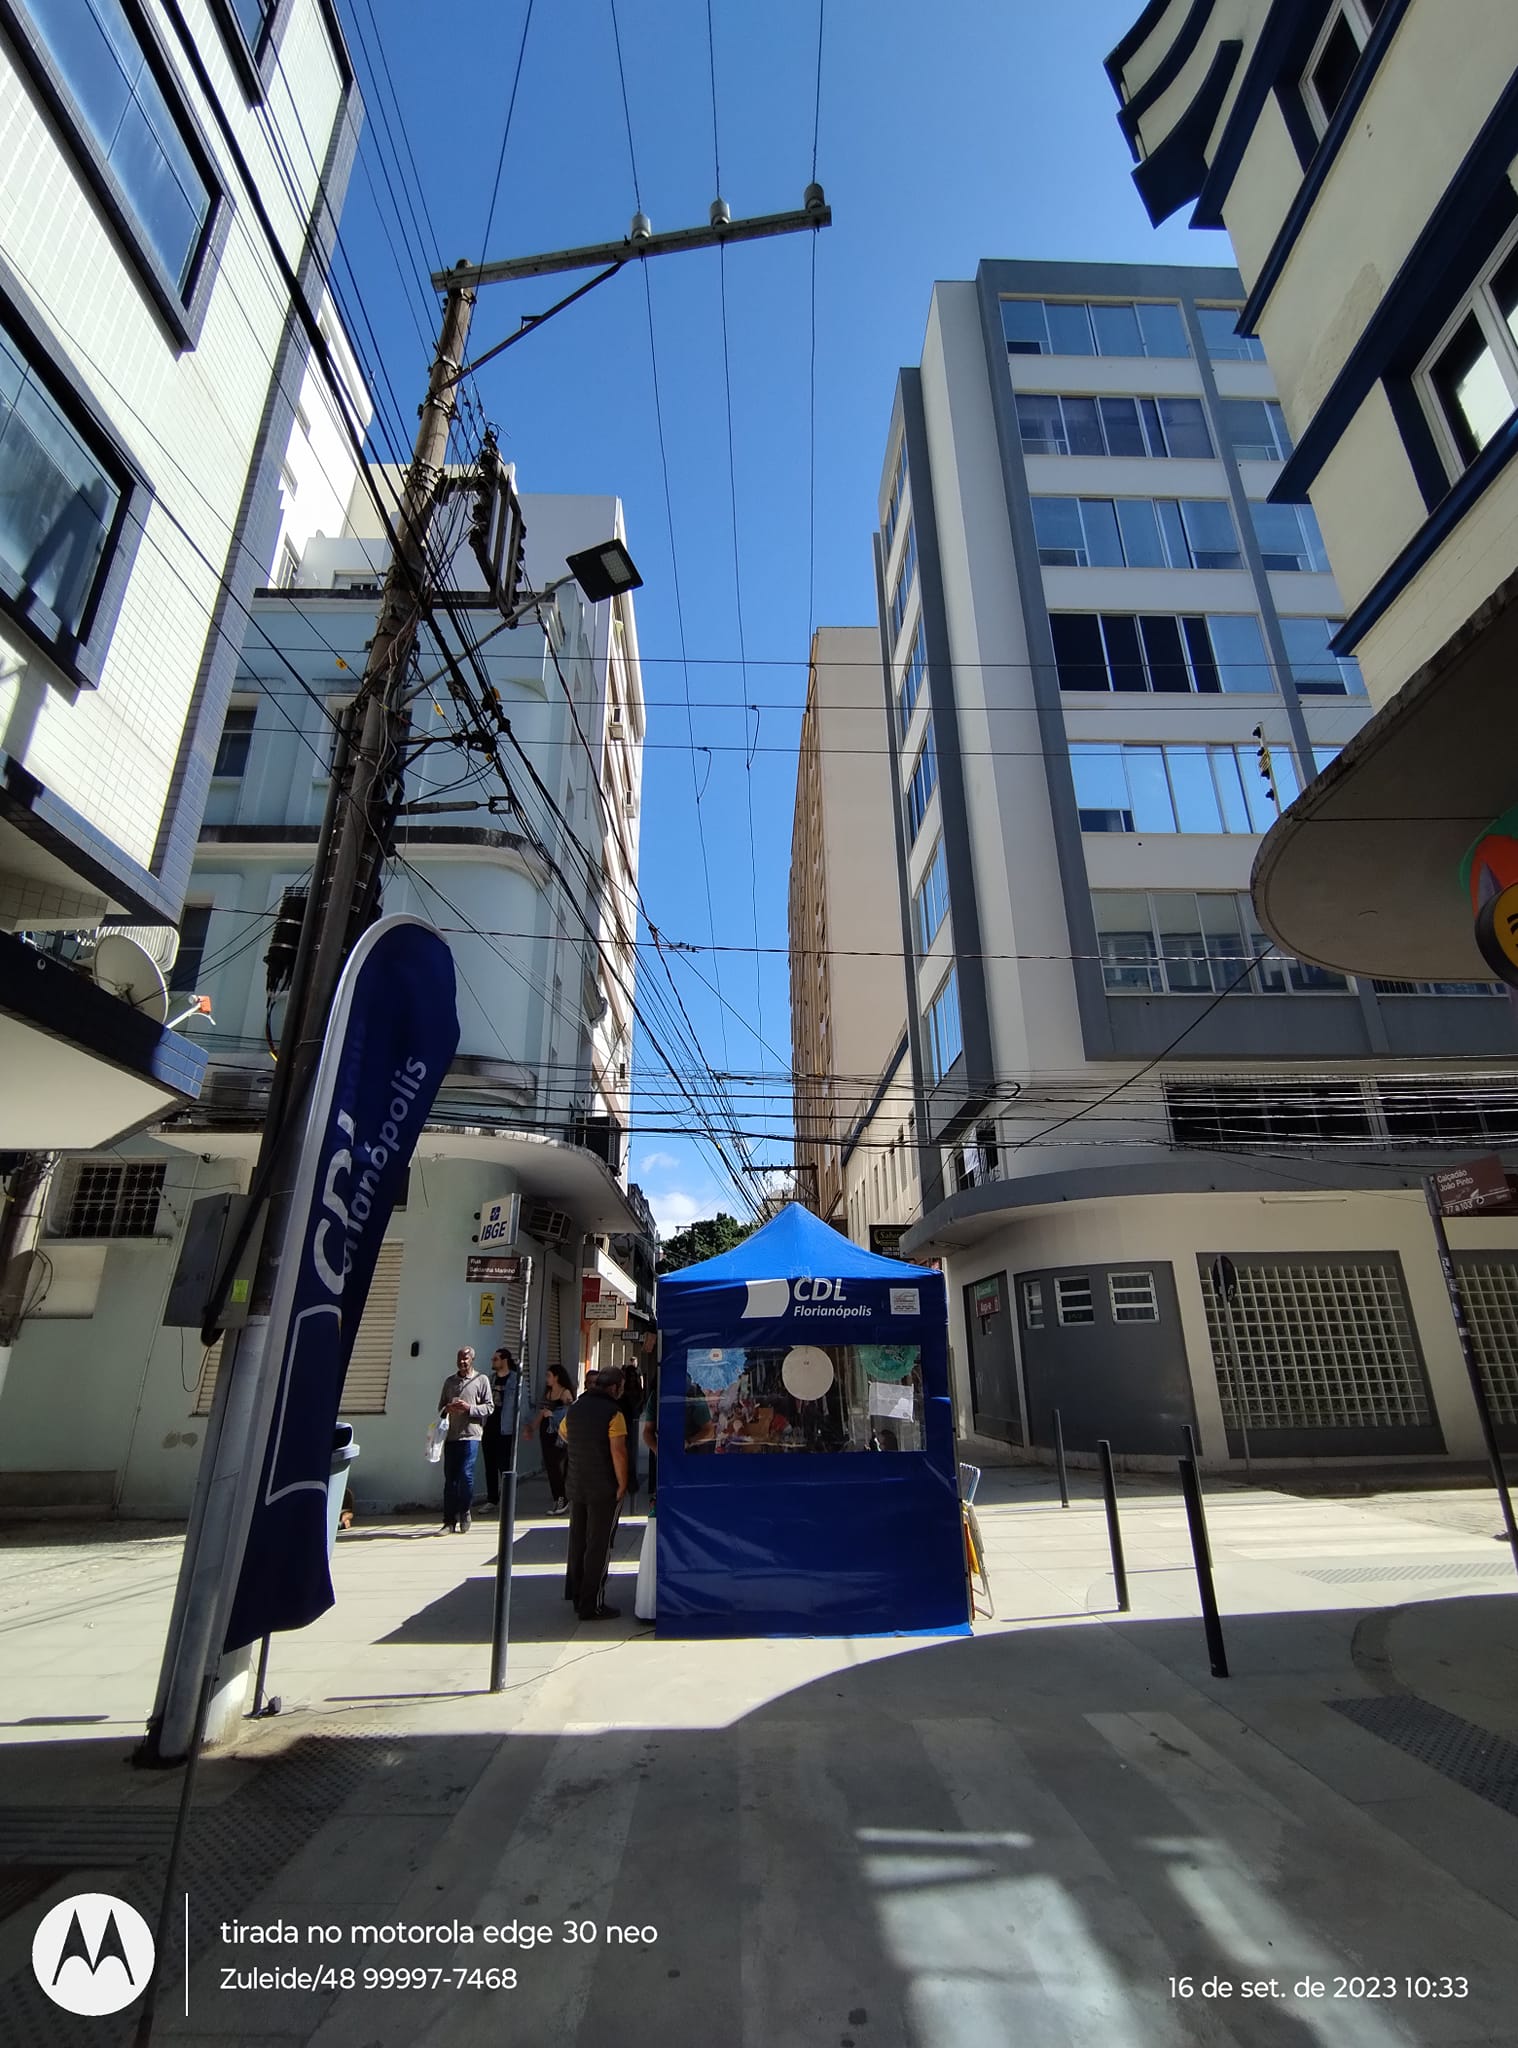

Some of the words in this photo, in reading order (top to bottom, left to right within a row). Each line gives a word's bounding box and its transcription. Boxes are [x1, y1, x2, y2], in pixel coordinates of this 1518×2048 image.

[1437, 1169, 1468, 1184] Calçadão
[1439, 1181, 1456, 1192] João
[1456, 1177, 1474, 1188] Pinto
[1445, 1205, 1454, 1214] 77
[1460, 1199, 1473, 1211] 103
[480, 1219, 508, 1242] IBGE
[494, 1266, 516, 1274] Marinho
[793, 1277, 848, 1302] CDL
[793, 1304, 873, 1320] Florianópolis
